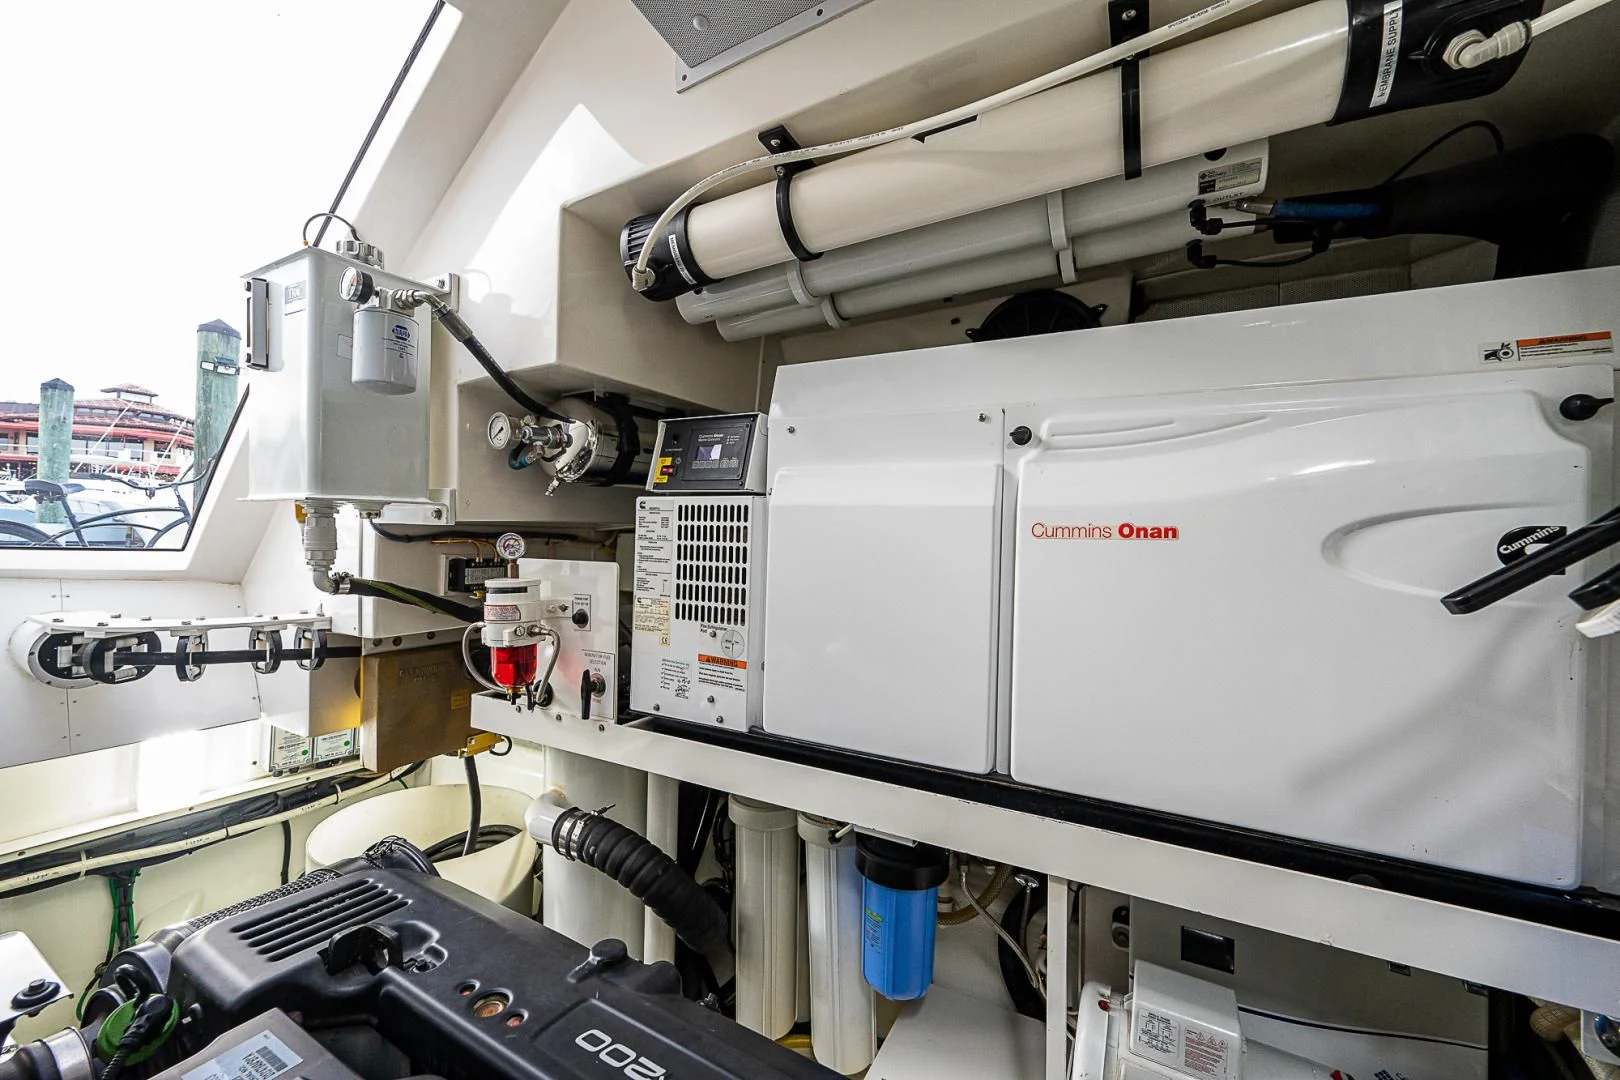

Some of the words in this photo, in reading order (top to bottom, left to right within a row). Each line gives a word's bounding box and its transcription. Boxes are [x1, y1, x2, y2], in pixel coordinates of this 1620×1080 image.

[1377, 47, 1396, 98] MEMBRANE
[1387, 8, 1399, 46] SUPPLY
[1031, 522, 1112, 538] Cummins
[1118, 522, 1178, 539] Onan
[1499, 526, 1560, 554] Cummins
